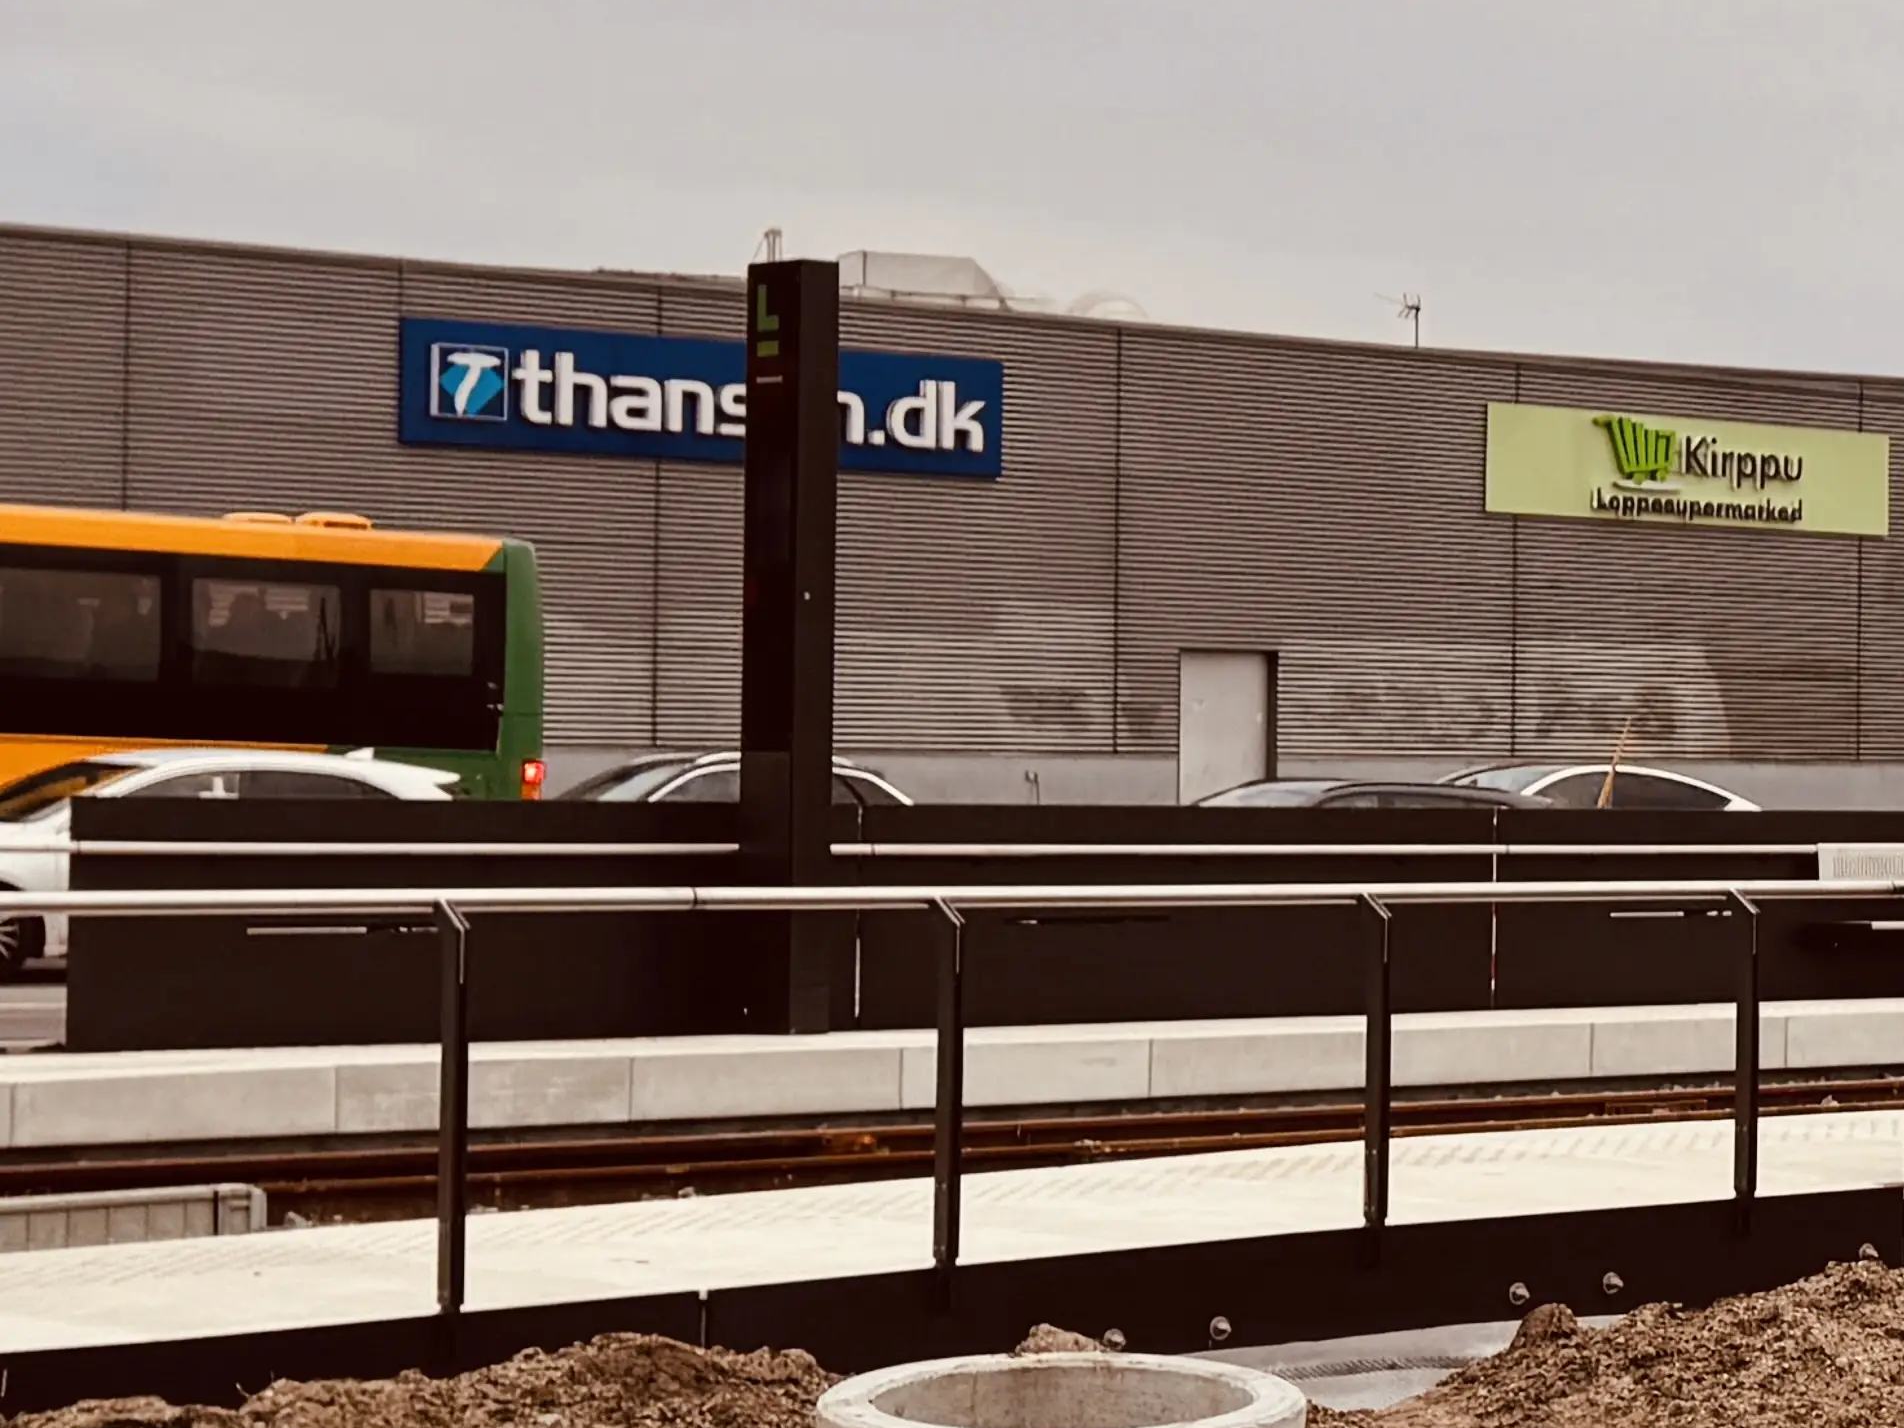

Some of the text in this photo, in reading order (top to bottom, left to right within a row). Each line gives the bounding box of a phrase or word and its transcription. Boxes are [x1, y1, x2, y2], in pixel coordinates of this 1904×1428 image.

[512, 349, 986, 453] thansn.dk
[1683, 435, 1803, 491] Kirppu
[1592, 486, 1803, 522] Loppesupermarked
